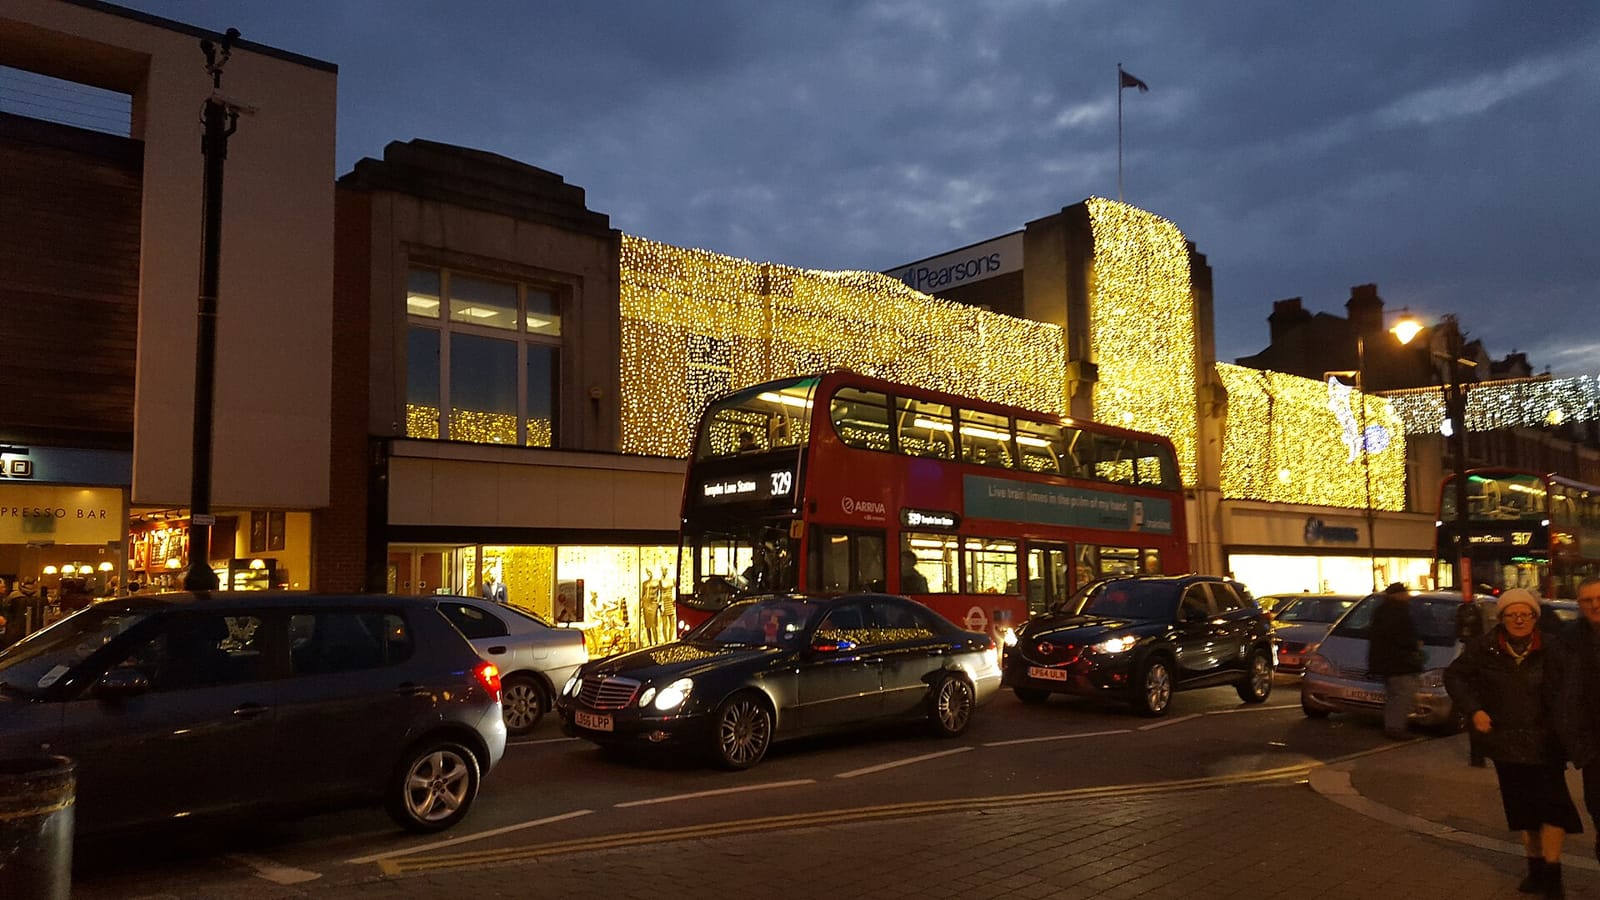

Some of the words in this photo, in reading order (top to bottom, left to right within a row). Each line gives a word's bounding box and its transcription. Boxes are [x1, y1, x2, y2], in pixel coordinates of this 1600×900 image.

[917, 253, 1000, 289] Pearsons
[770, 471, 792, 496] 329
[77, 508, 106, 519] BAR
[855, 501, 885, 514] ARRIVA
[592, 715, 609, 729] LPP
